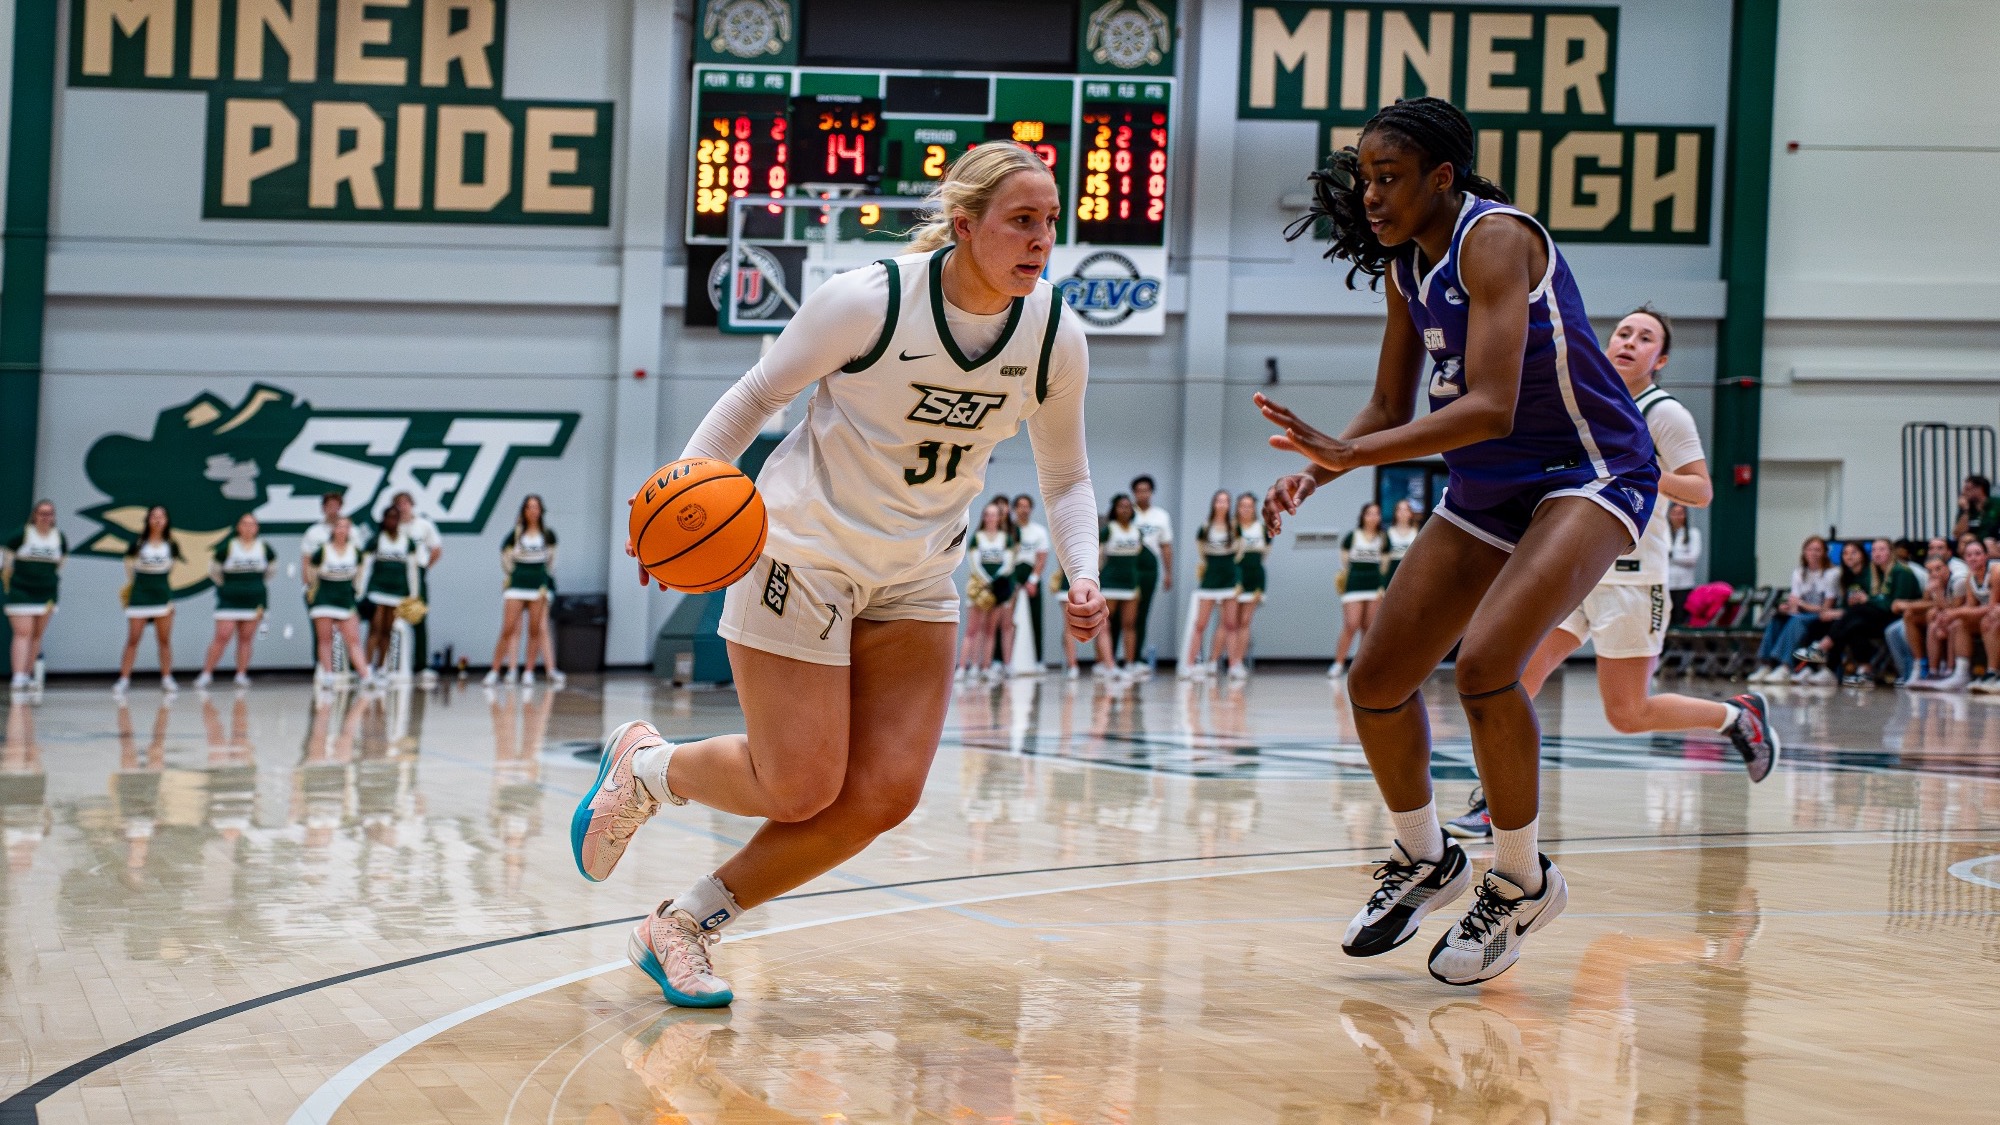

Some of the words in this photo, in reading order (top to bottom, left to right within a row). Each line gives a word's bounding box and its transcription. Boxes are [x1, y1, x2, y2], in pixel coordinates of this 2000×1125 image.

[82, 0, 498, 89] MINER
[1249, 7, 1609, 115] MINER
[735, 116, 751, 139] 0
[771, 117, 787, 140] 2
[1095, 125, 1111, 148] 2
[1116, 126, 1132, 148] 2
[222, 98, 598, 214] PRIDE
[698, 140, 729, 163] 22
[734, 141, 751, 163] 0
[827, 133, 864, 175] 14
[924, 145, 946, 177] 2
[1115, 150, 1131, 172] 0
[1149, 151, 1166, 173] 0
[698, 164, 728, 187] 31
[733, 165, 750, 188] 0
[769, 166, 785, 189] 0
[1086, 173, 1110, 196] 15
[1148, 175, 1165, 196] 0
[1331, 126, 1700, 232] UGH
[1078, 197, 1109, 220] 23
[1147, 198, 1164, 220] 2
[1058, 277, 1160, 310] GLVC
[1000, 366, 1027, 377] GLVC
[909, 384, 1006, 428] S&T
[252, 416, 563, 523] S&T
[645, 465, 690, 505] EVO
